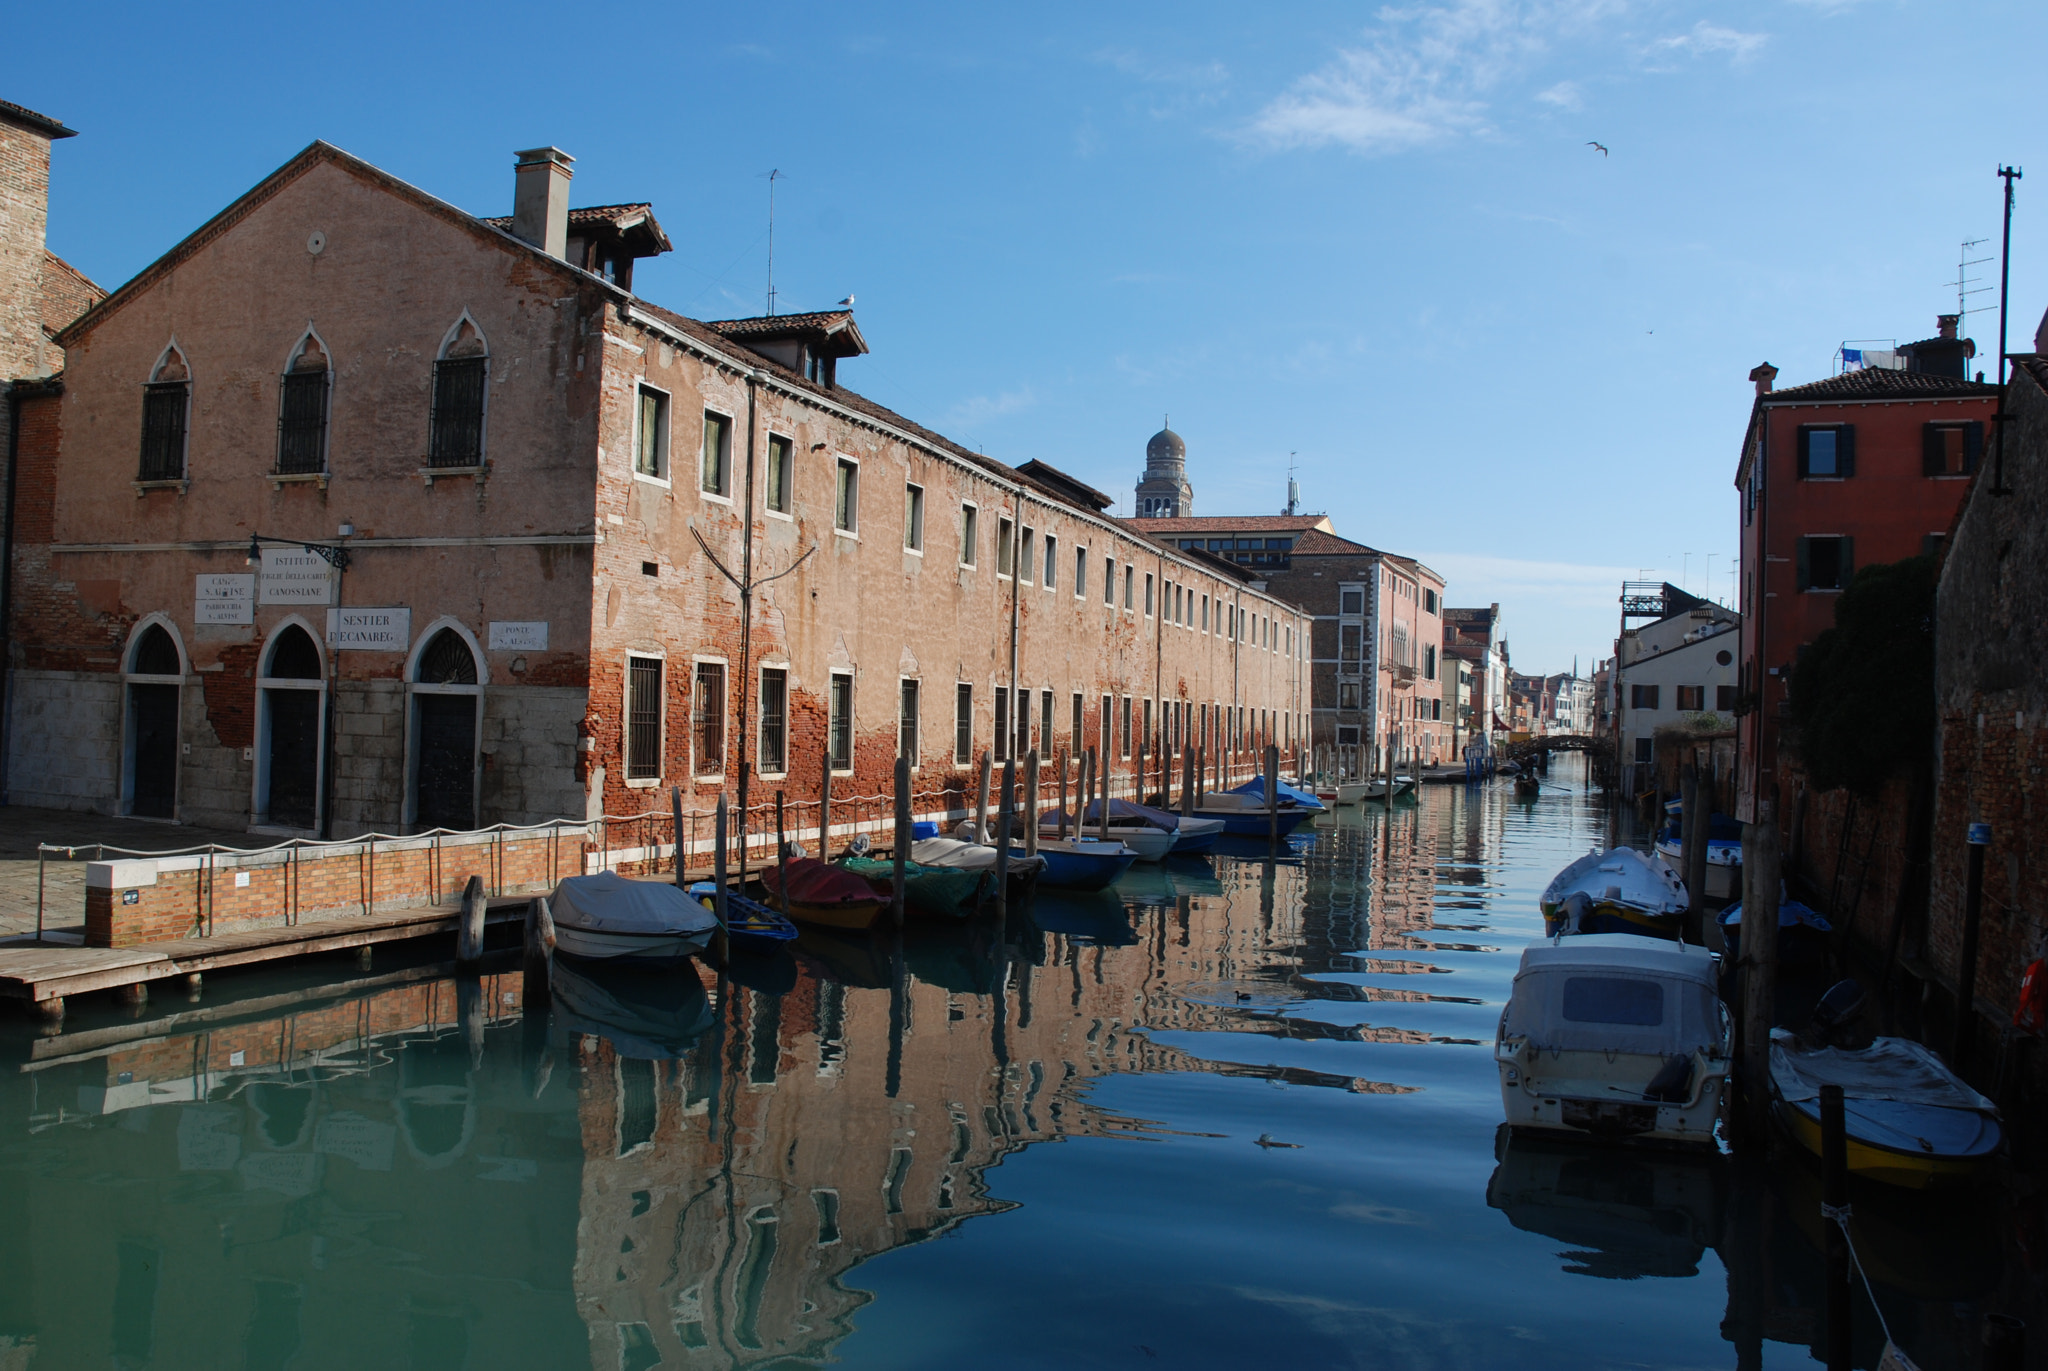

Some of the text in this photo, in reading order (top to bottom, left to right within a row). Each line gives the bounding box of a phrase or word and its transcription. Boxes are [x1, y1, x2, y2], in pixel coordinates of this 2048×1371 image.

[275, 557, 317, 566] ISTITUTO
[212, 577, 238, 585] CAM
[215, 588, 245, 596] ALISE
[269, 588, 322, 596] CANOSSIANE
[343, 615, 391, 626] SESTIER
[505, 626, 530, 634] PONTE
[510, 637, 537, 645] ALVS
